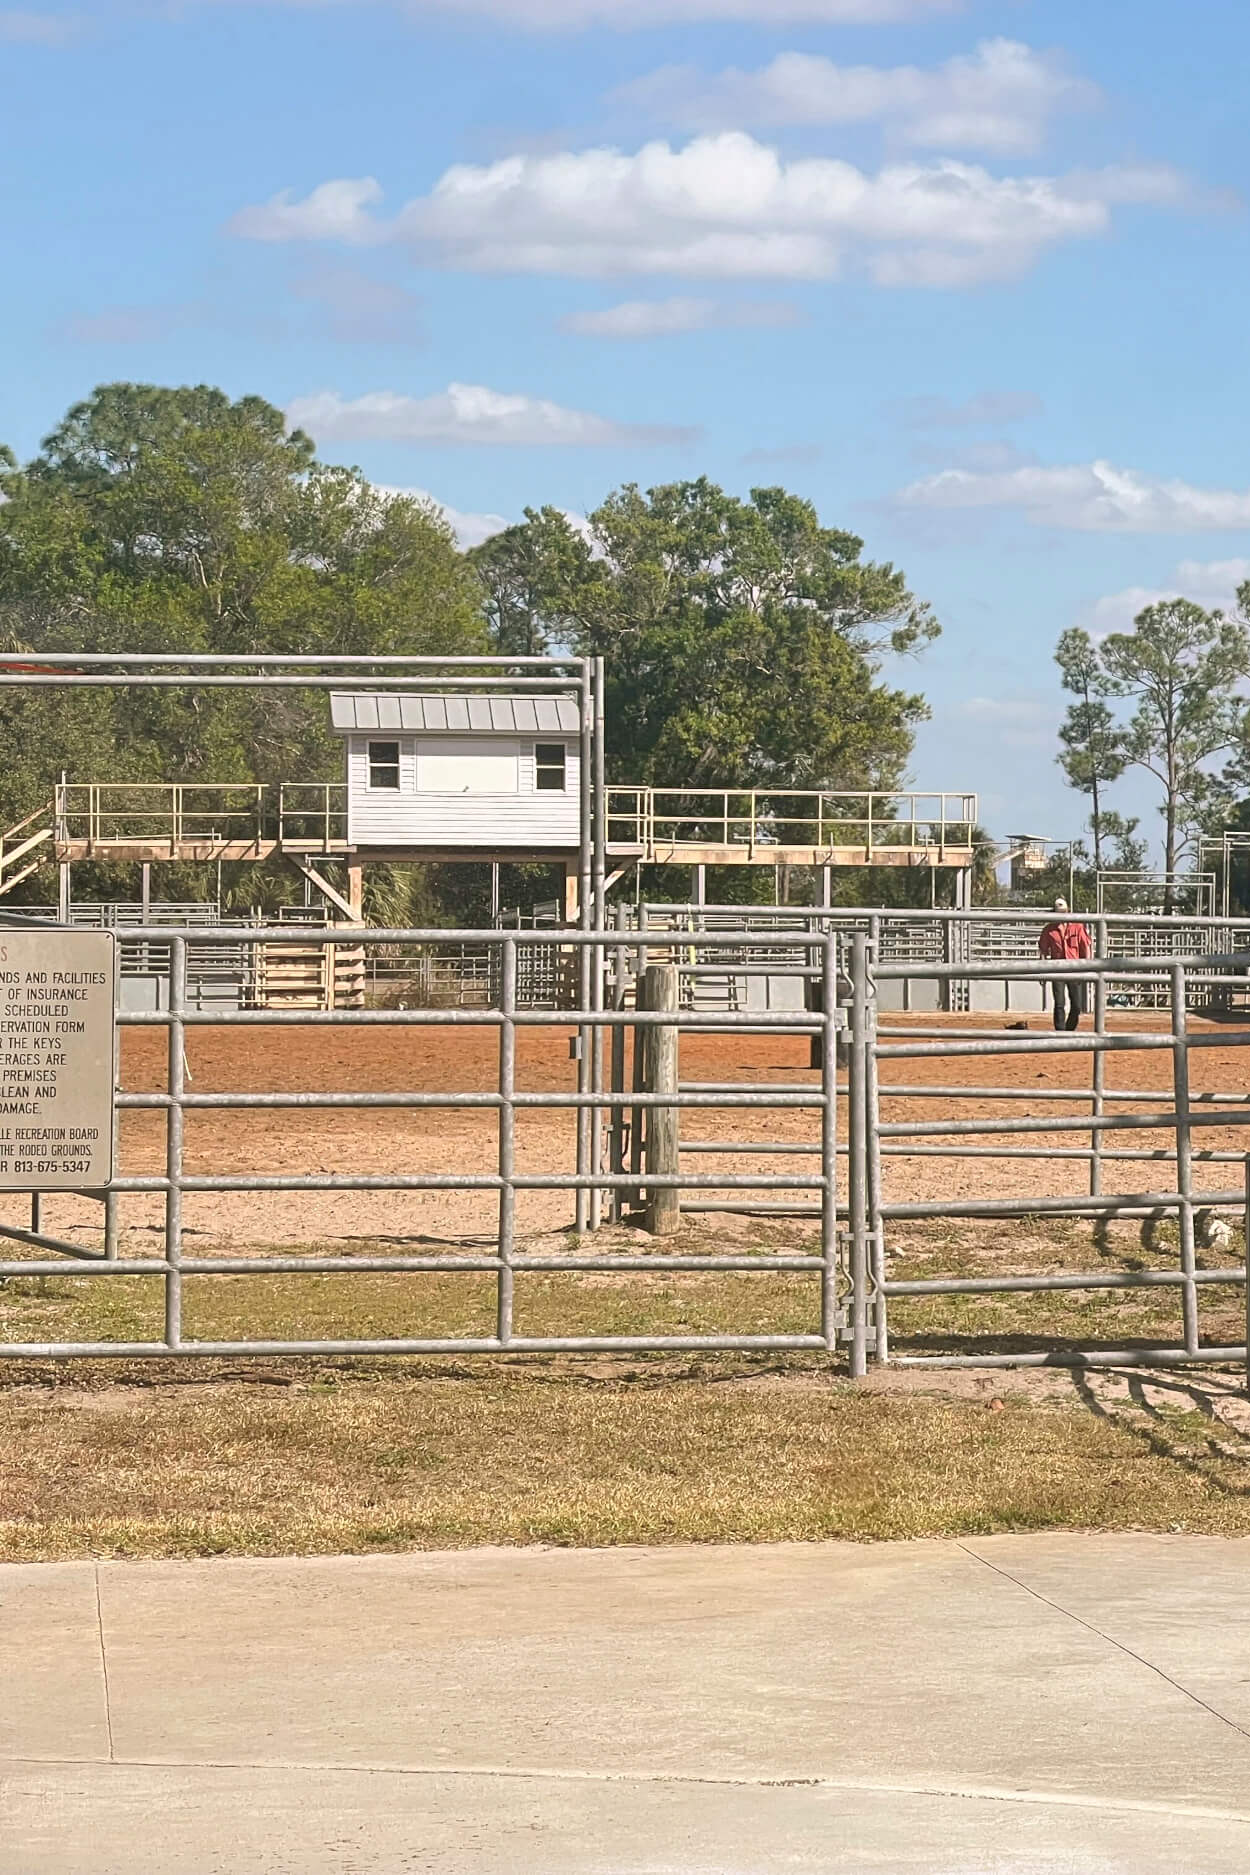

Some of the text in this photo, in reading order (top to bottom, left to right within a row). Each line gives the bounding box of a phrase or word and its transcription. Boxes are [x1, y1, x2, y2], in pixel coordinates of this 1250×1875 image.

[1, 946, 8, 962] S
[0, 972, 106, 984] NDS AND FACILITIES
[8, 988, 22, 1000] OF
[27, 988, 88, 1000] INSURANCE
[5, 1004, 69, 1017] SCHEDULED
[1, 1021, 85, 1033] ERVATION FORM
[8, 1037, 28, 1049] THE
[33, 1037, 61, 1049] KEYS
[0, 1053, 67, 1065] ERAGES ARE
[3, 1070, 57, 1082] PREMISES
[0, 1086, 57, 1098] LEAN AND
[0, 1128, 99, 1140] LE RECREATION BOARD
[0, 1144, 93, 1156] THE RODEO GROUNDS.
[0, 1160, 91, 1173] R 813-675-5347
